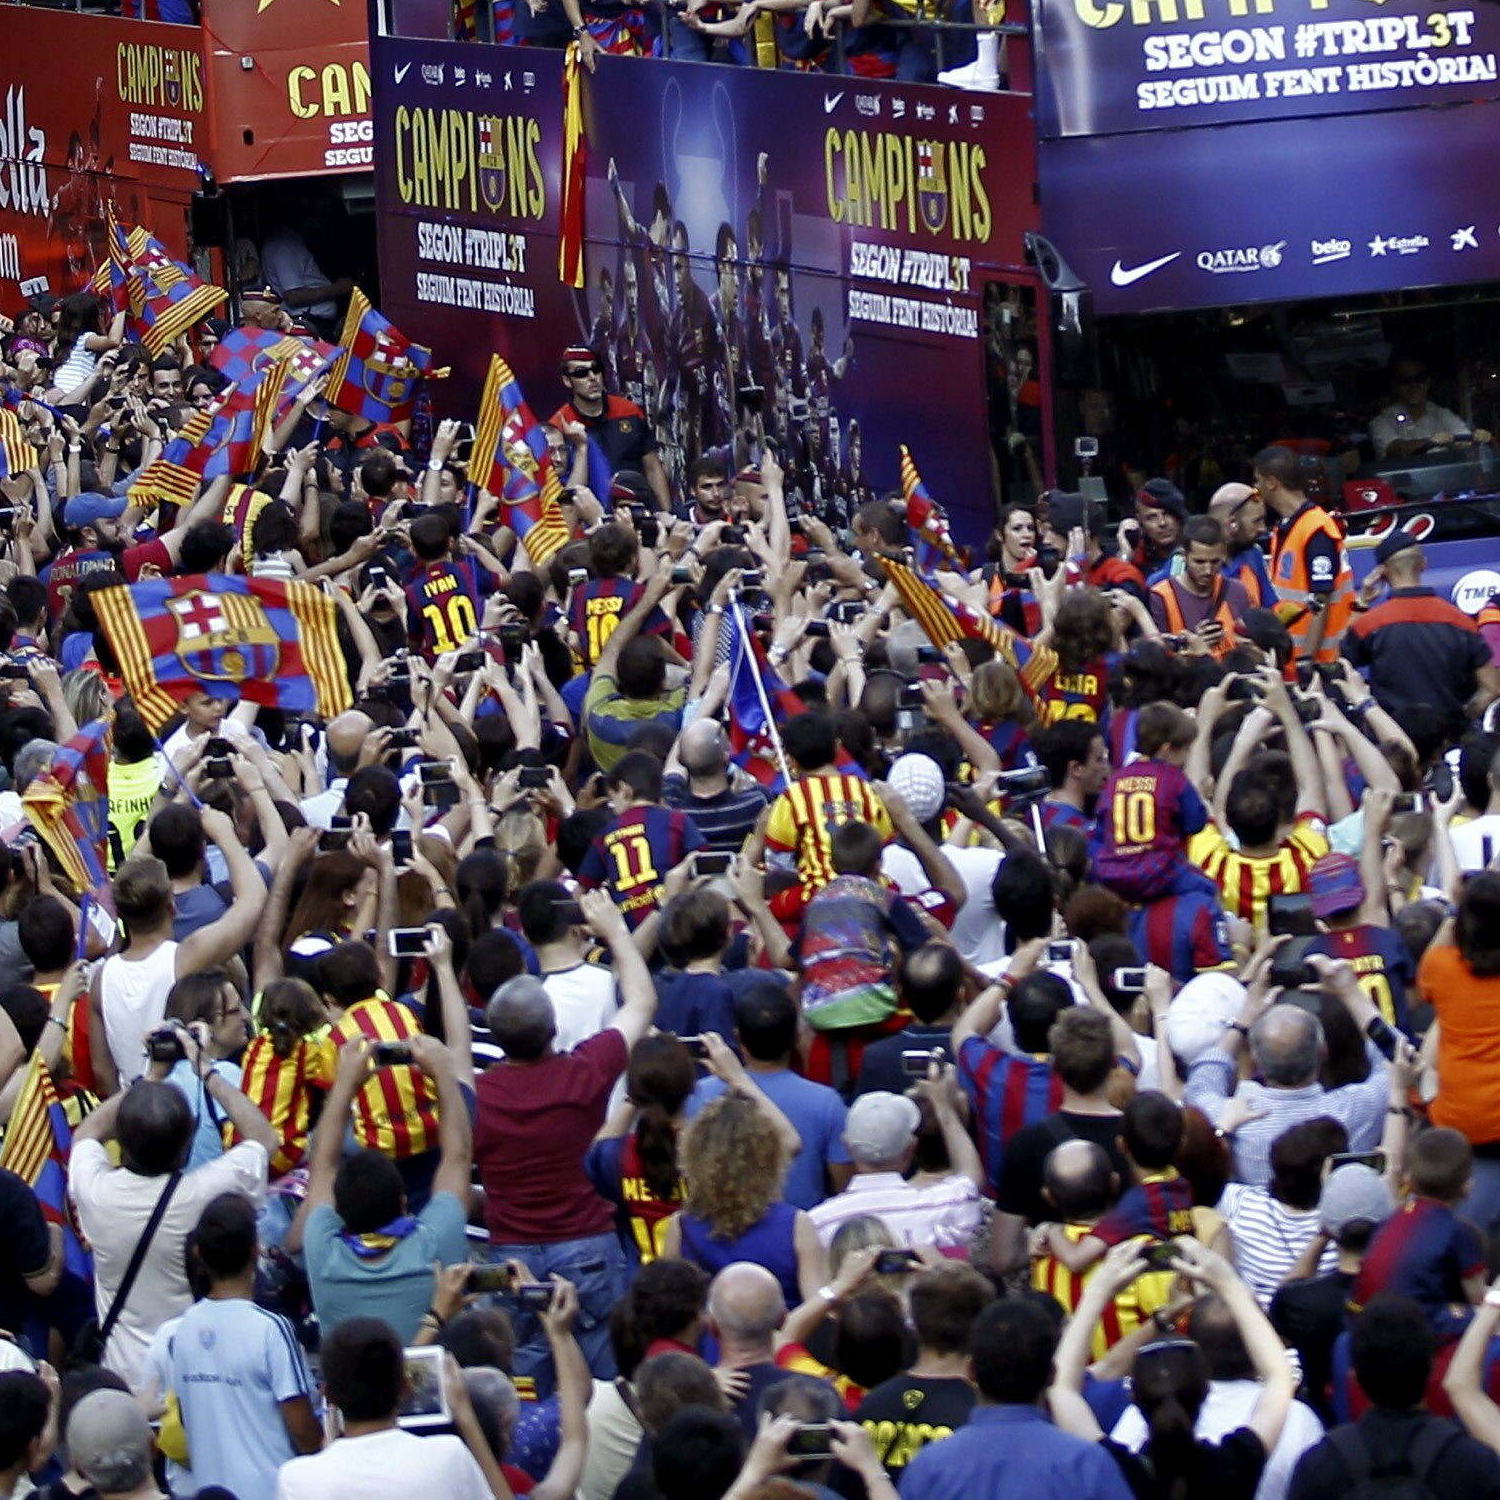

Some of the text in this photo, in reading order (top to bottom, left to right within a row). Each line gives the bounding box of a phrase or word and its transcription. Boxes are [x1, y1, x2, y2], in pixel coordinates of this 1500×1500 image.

[1143, 10, 1475, 72] SEGON #TRIPL3T
[1137, 52, 1497, 109] SEGUIM FENT HISTÒRIA!
[417, 221, 526, 273] SEGON #TRIPL3T
[851, 241, 971, 294] SEGON #TRIPL3T
[1197, 247, 1258, 269] QATAR
[1311, 238, 1351, 256] beko
[416, 272, 535, 317] SEGUIM FENT HISTÒRIA!
[849, 290, 978, 338] SEGUIM FENT HISTÒRIA!
[423, 573, 457, 598] IVAN
[1464, 586, 1497, 600] TMB
[422, 594, 477, 655] 10
[1113, 792, 1156, 845] 10
[609, 836, 658, 891] 11
[622, 1177, 689, 1202] MEI
